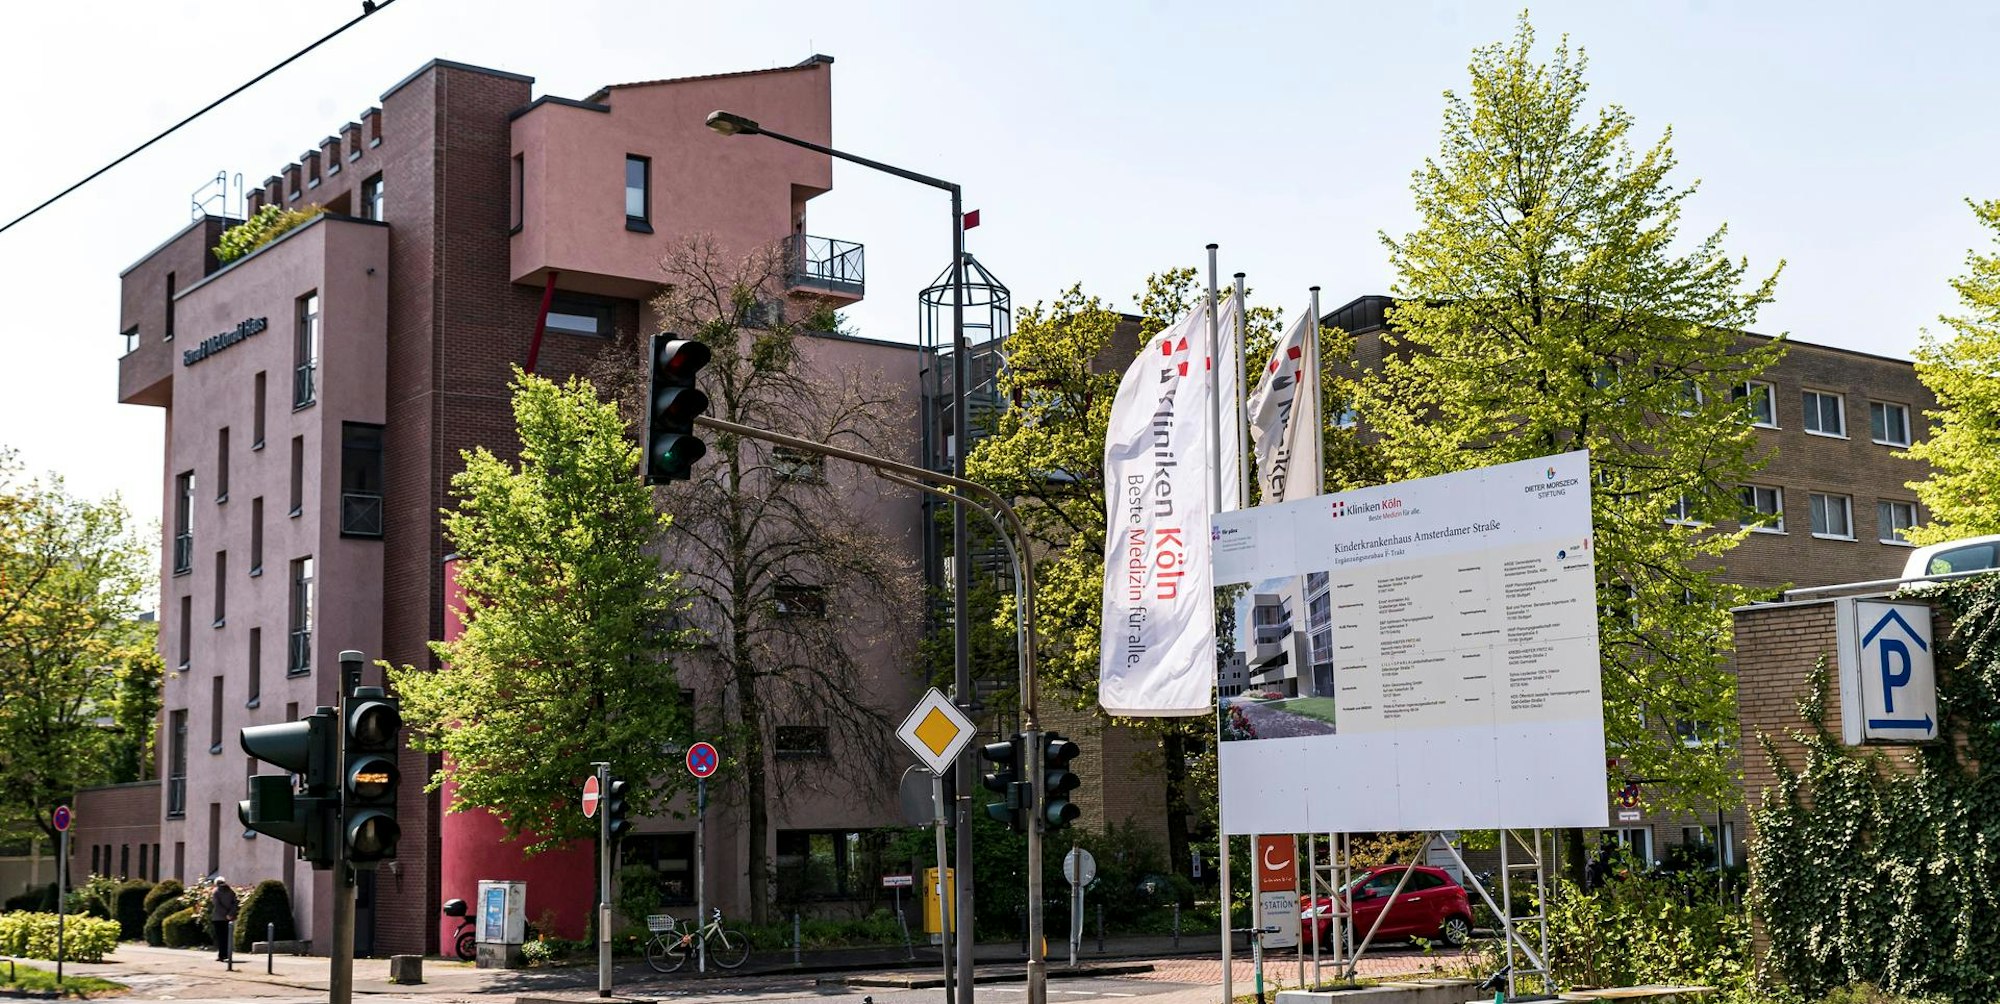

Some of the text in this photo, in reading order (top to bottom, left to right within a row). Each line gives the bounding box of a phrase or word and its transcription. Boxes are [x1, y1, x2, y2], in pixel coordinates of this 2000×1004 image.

[1153, 389, 1185, 600] Kliniken Köln
[1525, 478, 1579, 493] DIETER MORSZECK
[1538, 489, 1566, 499] STIFTUNG
[1347, 498, 1402, 516] Kliniken Köln
[1383, 511, 1402, 519] Medizin
[1402, 508, 1410, 516] für
[1334, 520, 1500, 553] Kinderkrankenhaus Amsterdamer Straße
[1128, 475, 1147, 668] Beste Medizin für alle.
[1879, 638, 1912, 714] P
[1264, 900, 1294, 910] STATION
